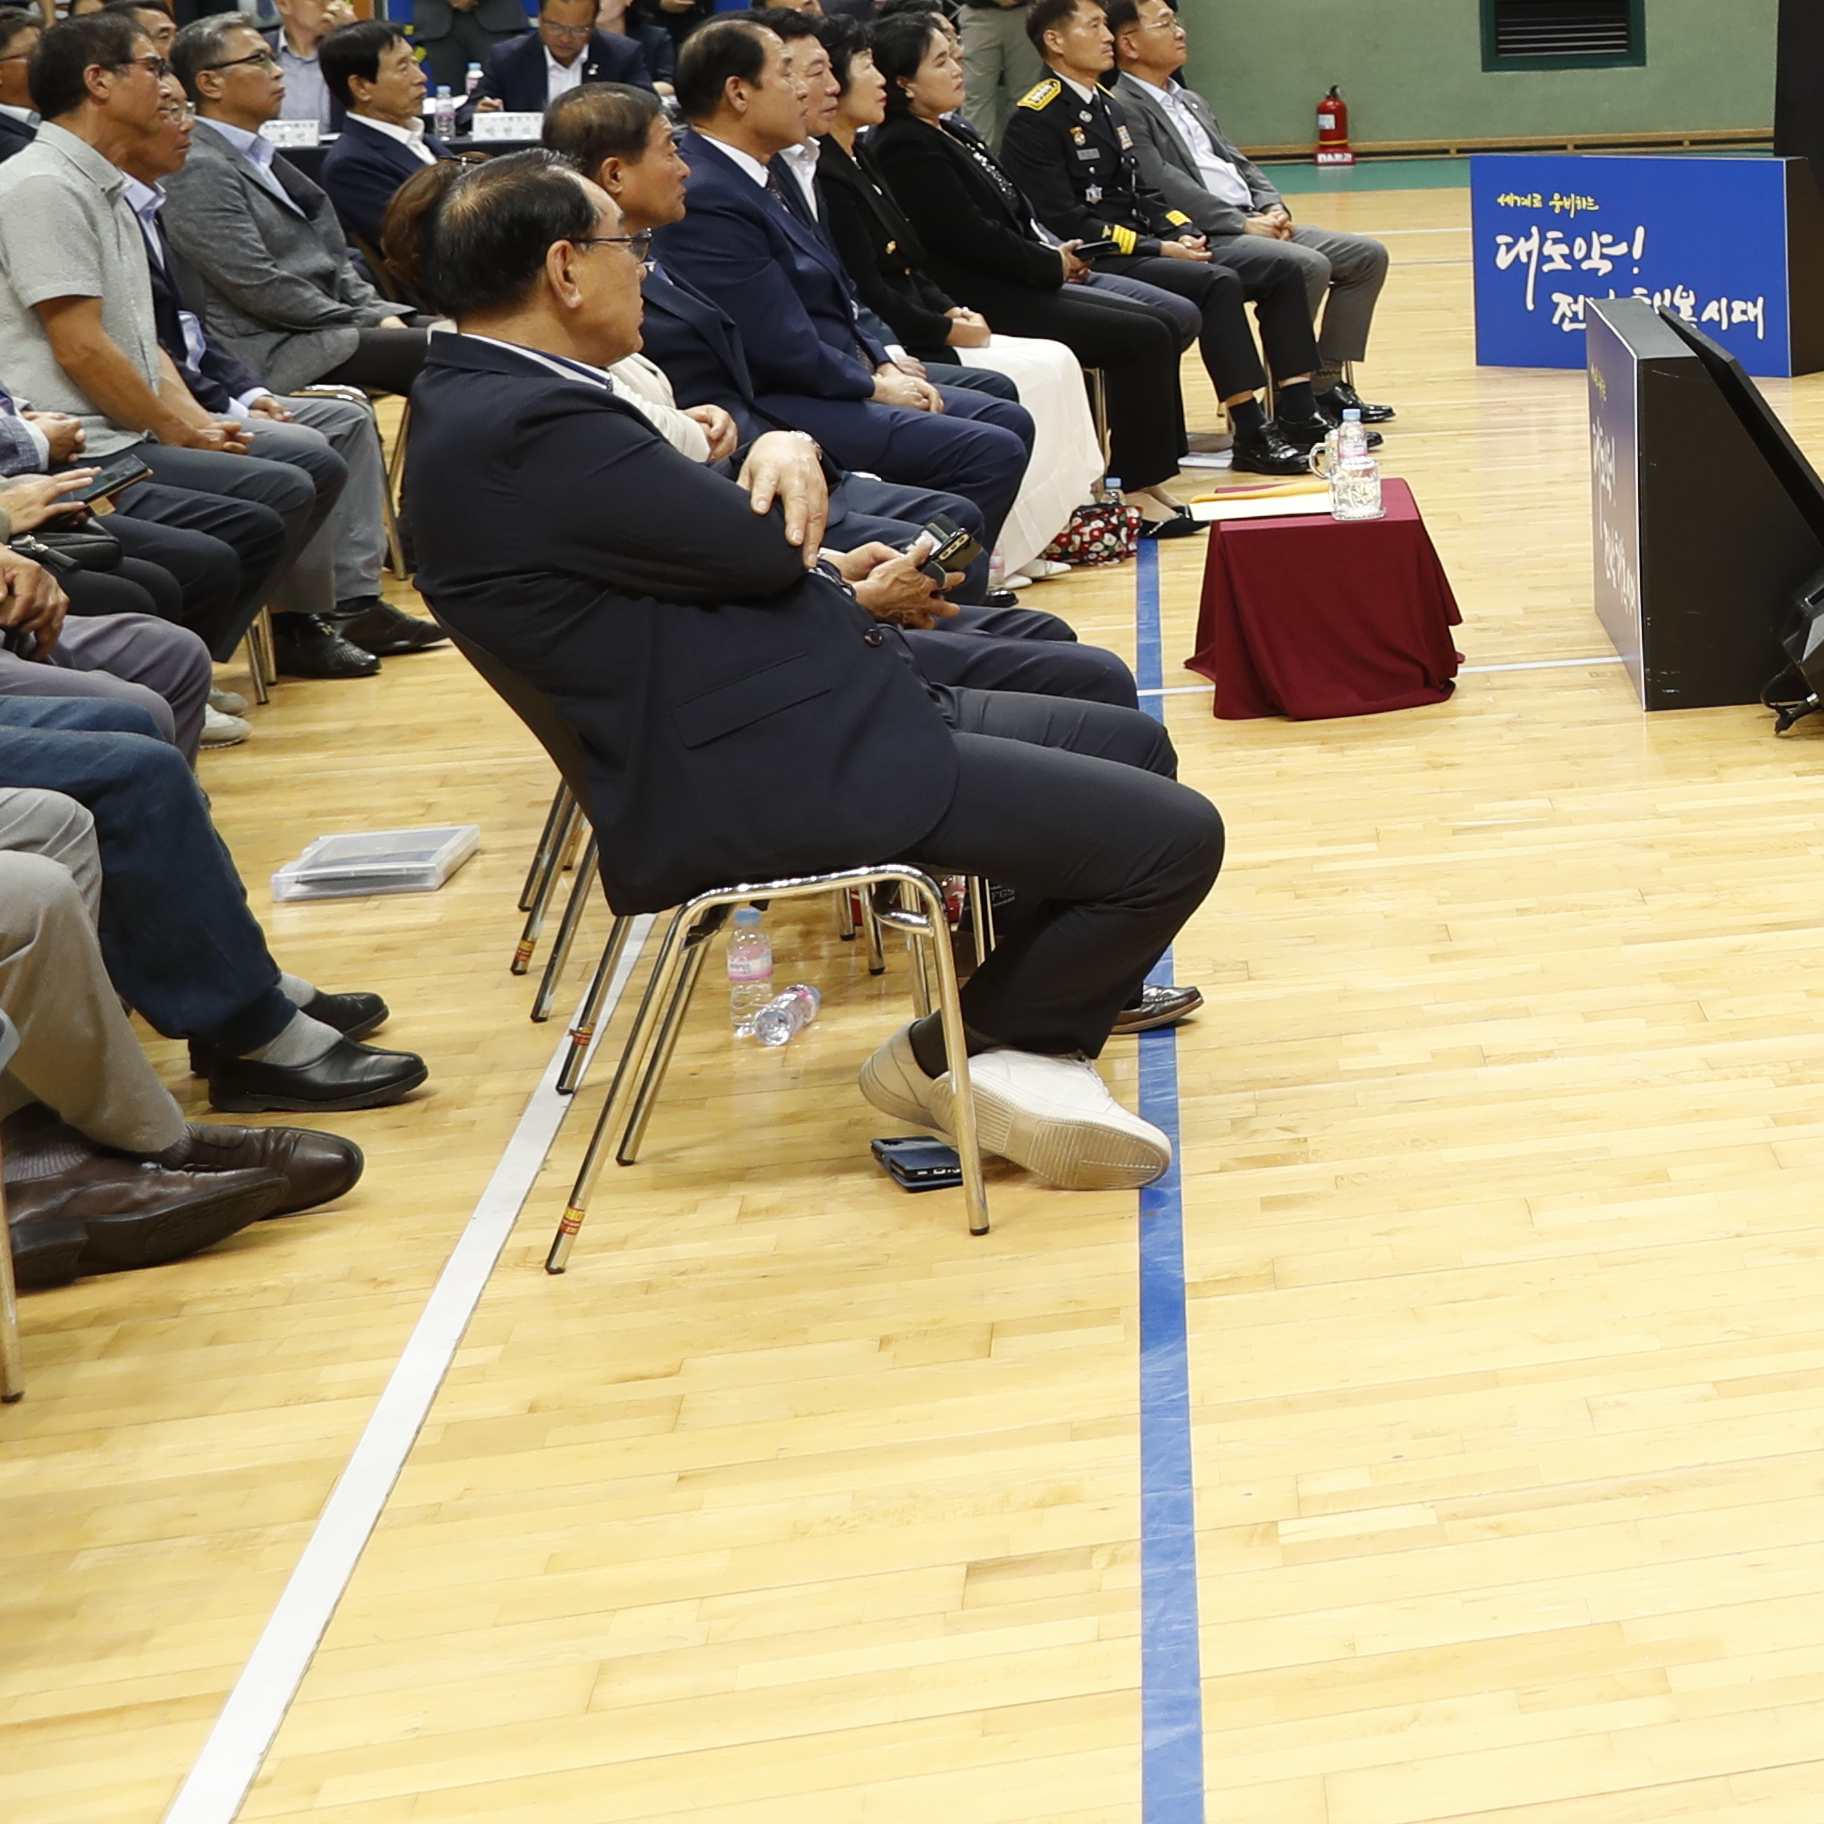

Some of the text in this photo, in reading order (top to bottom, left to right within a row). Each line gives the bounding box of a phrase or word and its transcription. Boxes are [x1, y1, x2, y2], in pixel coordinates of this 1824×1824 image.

[1497, 192, 1600, 219] 세계로 웅비하는
[1494, 225, 1646, 311] 대도약!
